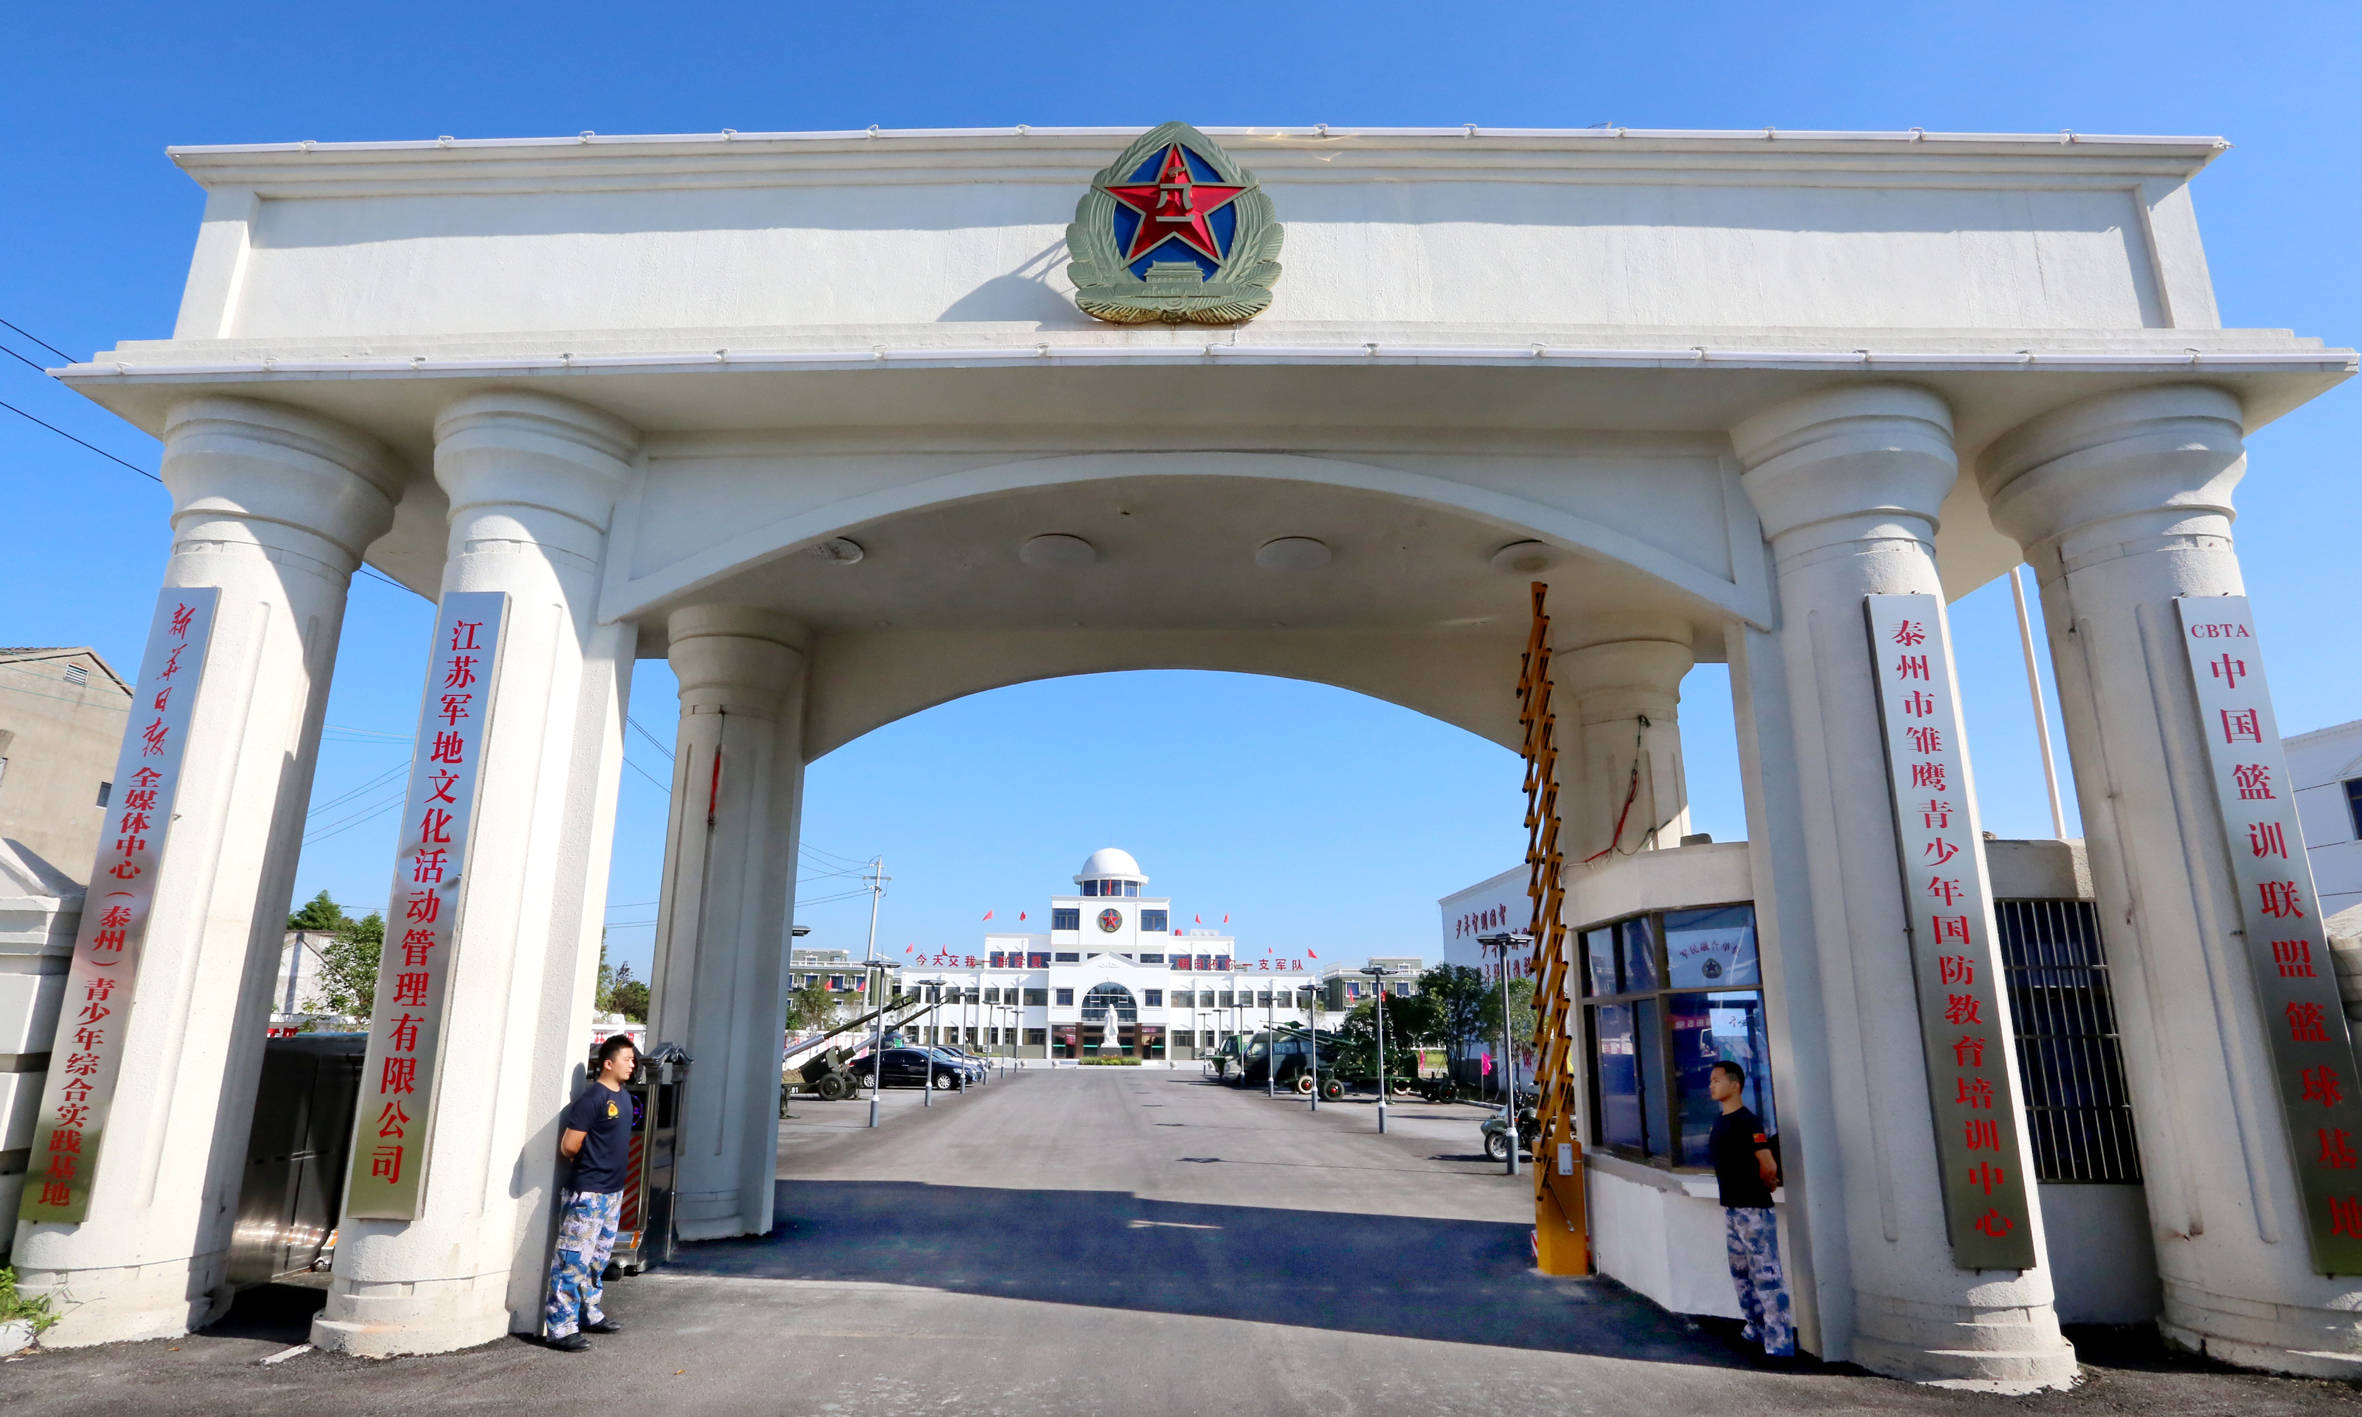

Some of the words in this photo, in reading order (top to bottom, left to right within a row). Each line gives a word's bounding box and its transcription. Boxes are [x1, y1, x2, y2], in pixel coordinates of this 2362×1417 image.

[371, 619, 484, 1185] 江苏军地文化活动管理有限公司
[2191, 623, 2250, 638] CBTA
[1889, 619, 2014, 1238] 泰州市雏鹰青少年国防教育培训中心
[2210, 653, 2362, 1239] 中国篮训联盟篮球基地
